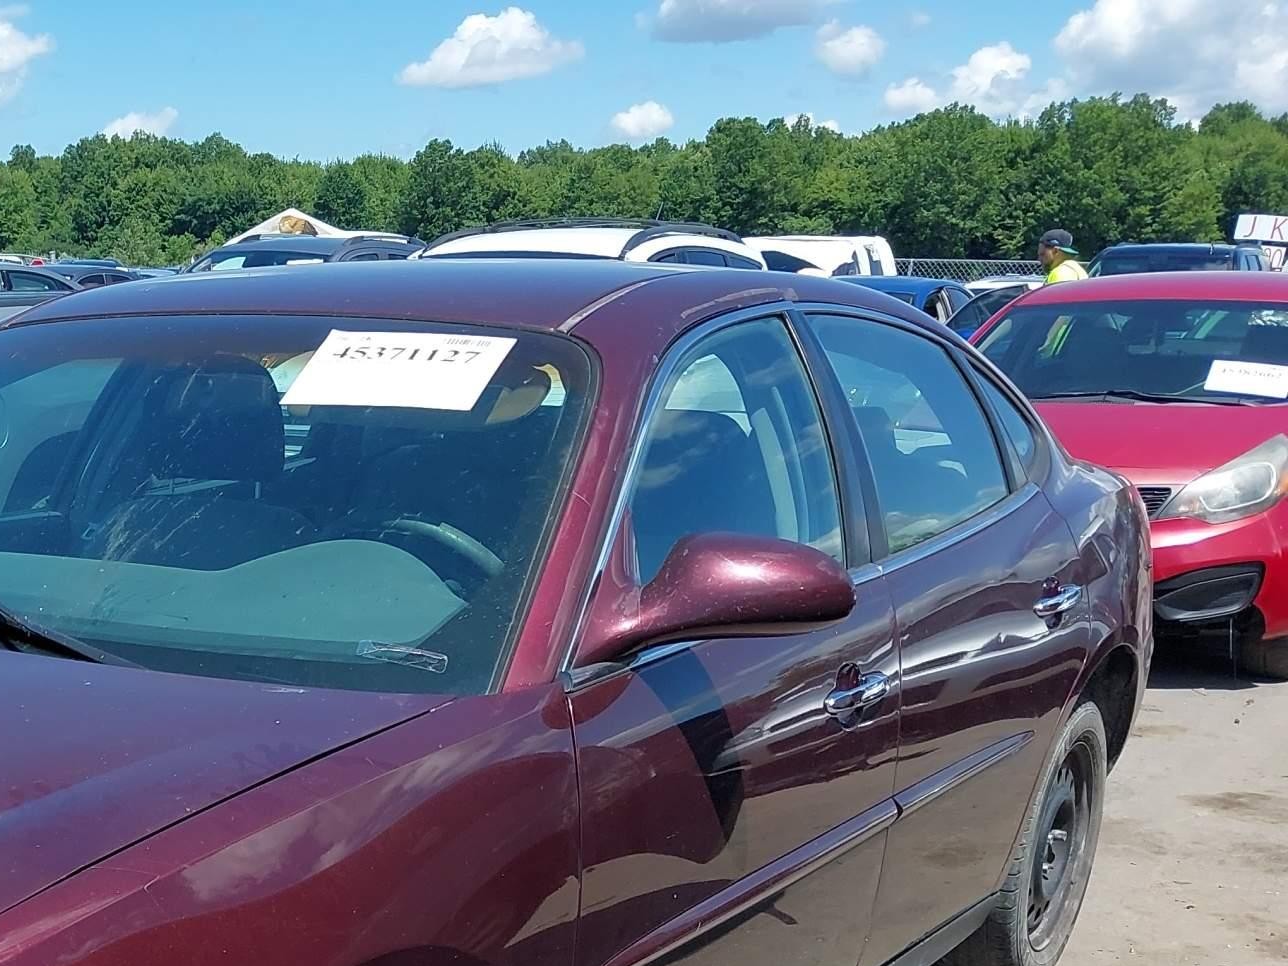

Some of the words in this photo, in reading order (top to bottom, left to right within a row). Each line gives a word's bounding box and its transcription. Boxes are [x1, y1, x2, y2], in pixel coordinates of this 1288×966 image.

[1243, 216, 1257, 238] J
[1270, 217, 1288, 240] K
[332, 345, 482, 364] 45371127
